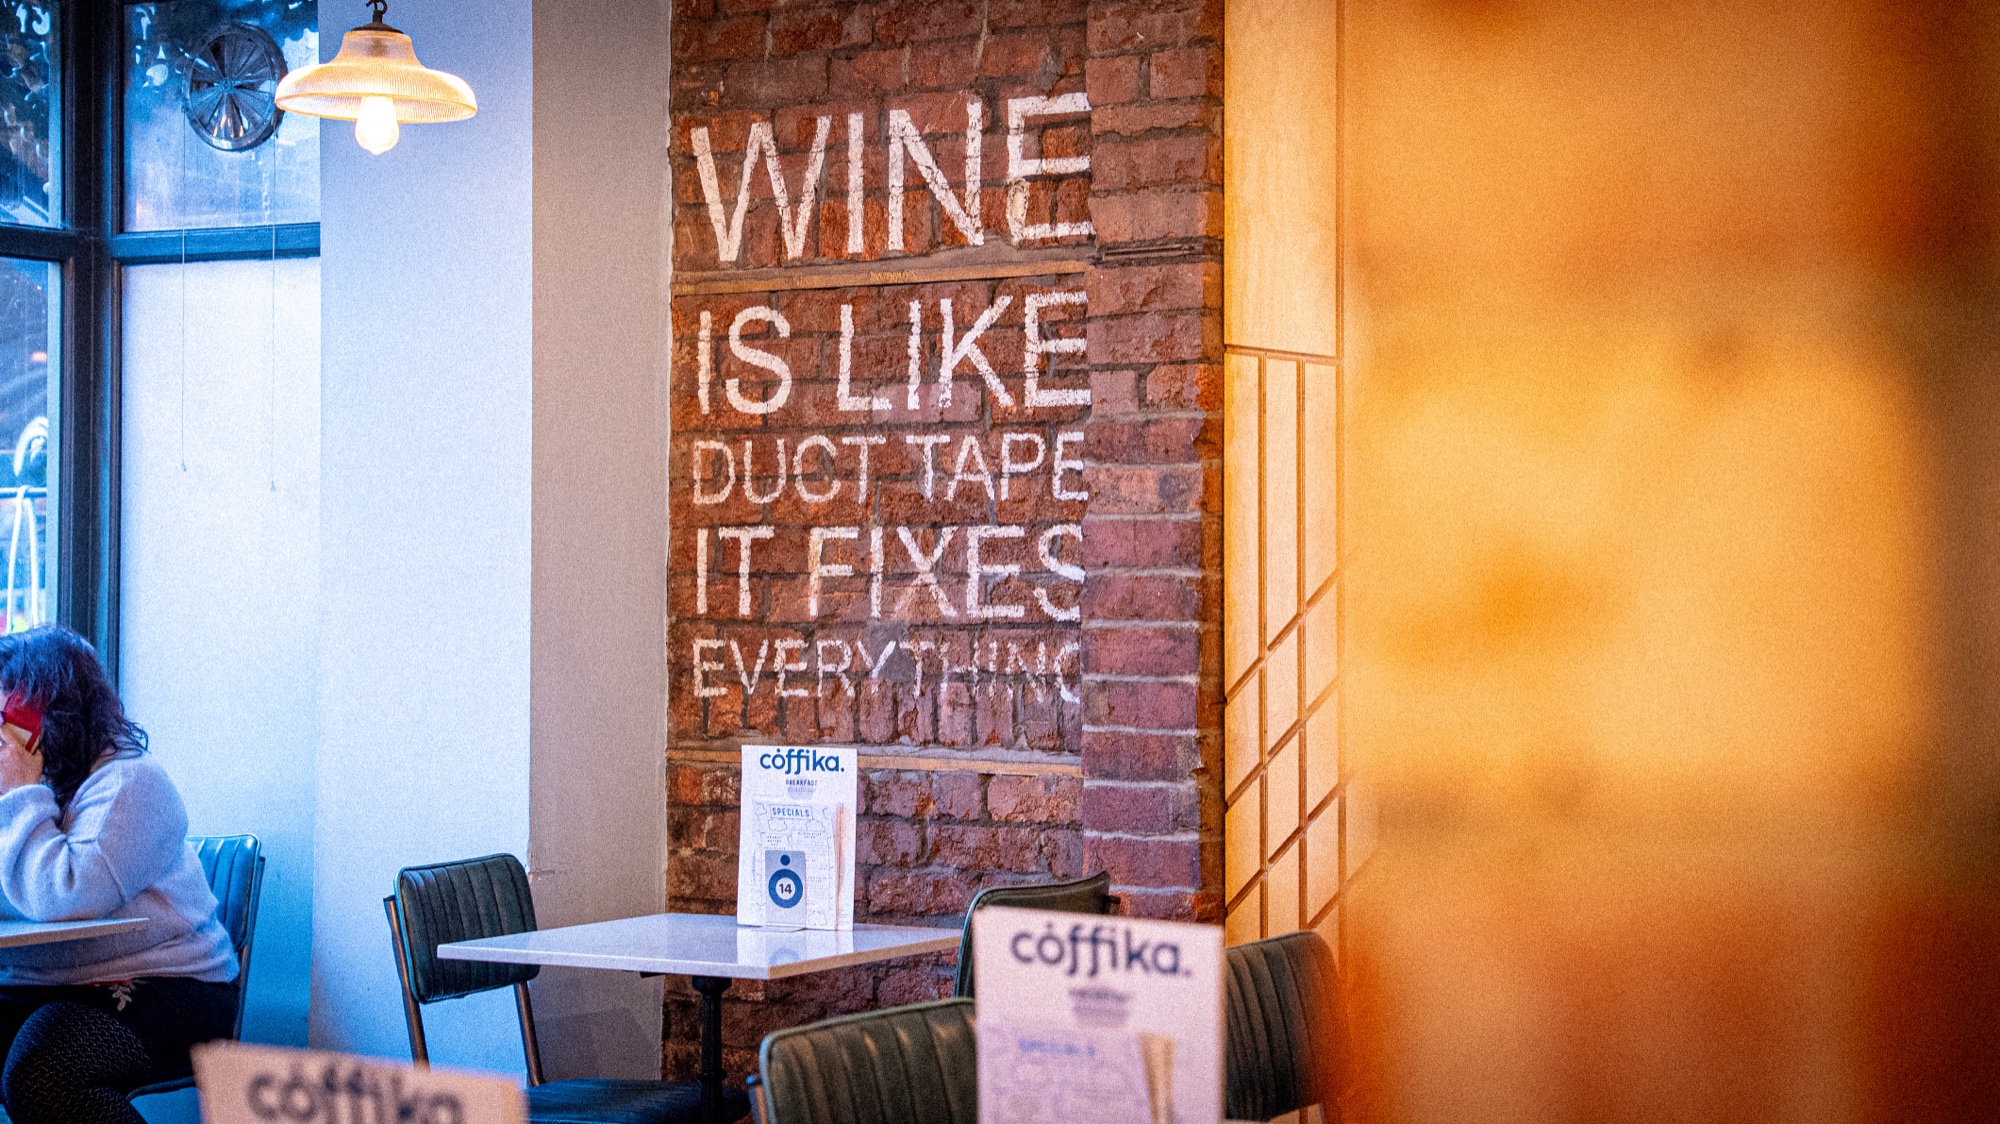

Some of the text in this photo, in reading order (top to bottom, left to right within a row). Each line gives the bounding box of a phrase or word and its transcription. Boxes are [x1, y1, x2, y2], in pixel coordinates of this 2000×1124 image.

[690, 92, 1095, 262] WINE
[697, 291, 1091, 415] IS LIKE
[692, 431, 1089, 505] DUCT TAPE
[696, 524, 1087, 622] IT FIXES
[771, 807, 810, 818] SPECIALS
[778, 883, 793, 895] 14
